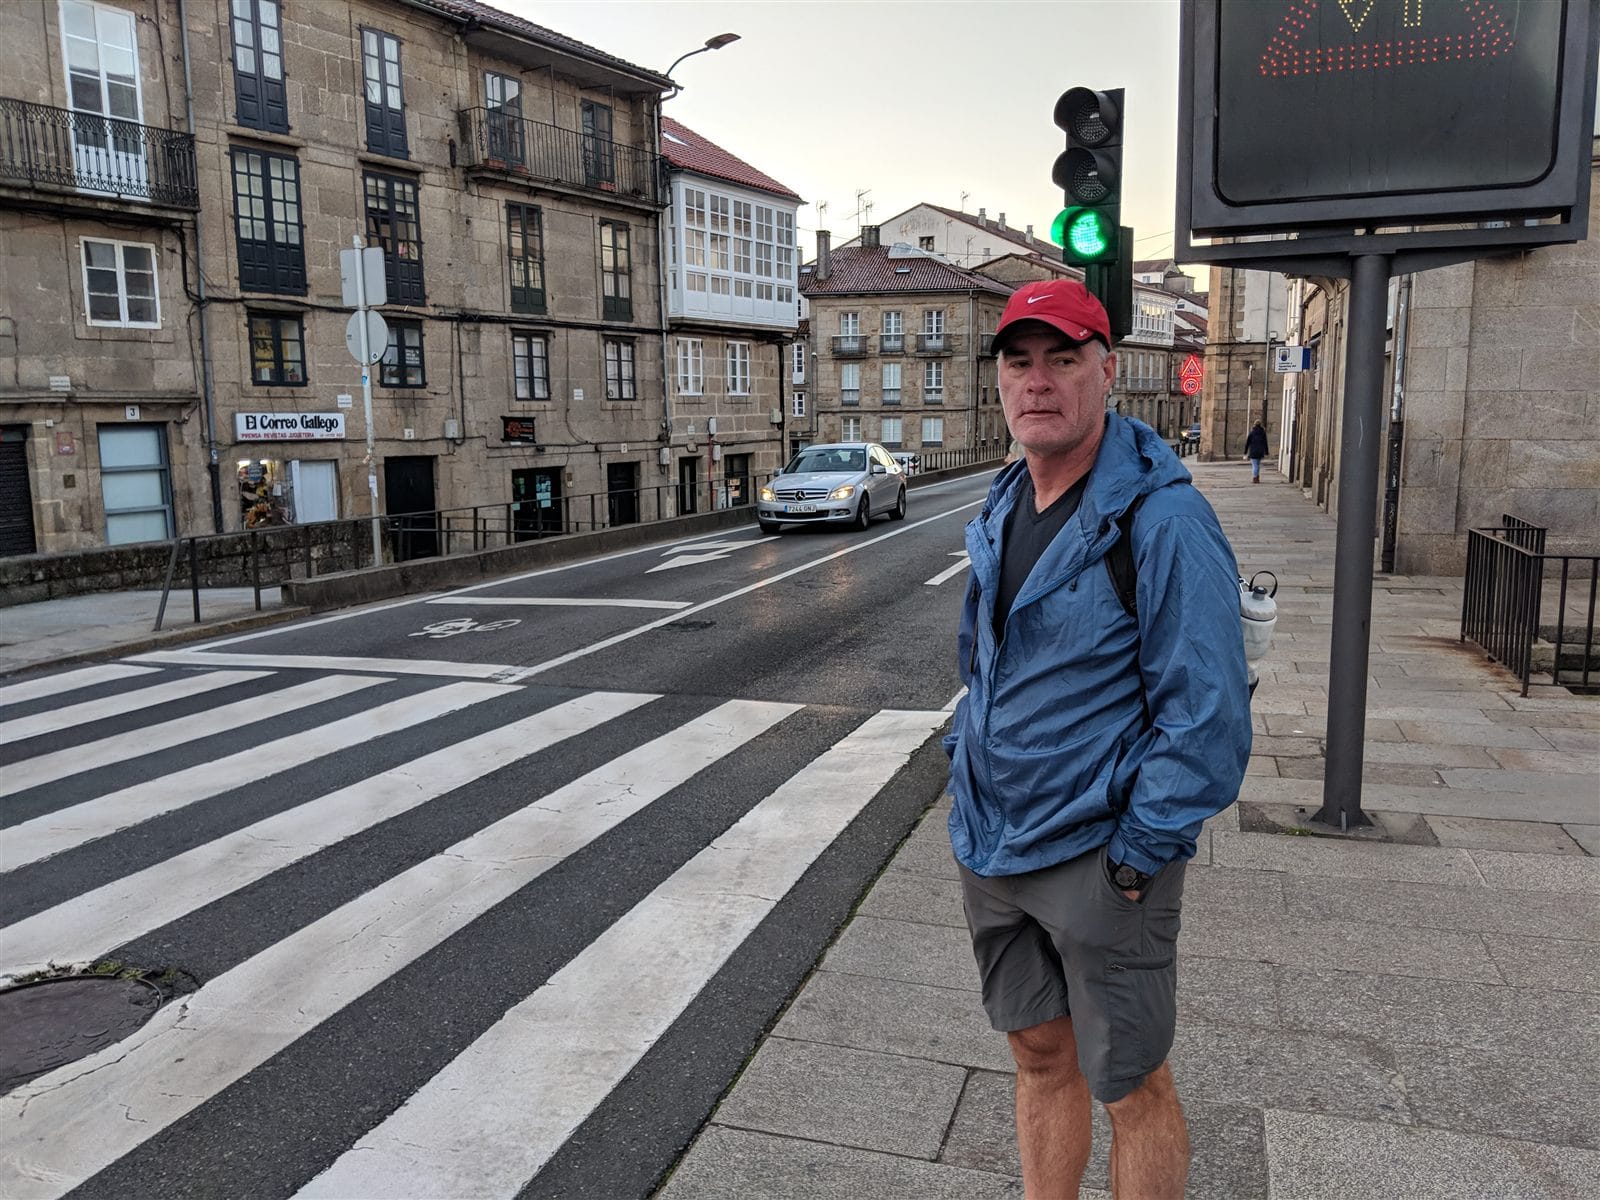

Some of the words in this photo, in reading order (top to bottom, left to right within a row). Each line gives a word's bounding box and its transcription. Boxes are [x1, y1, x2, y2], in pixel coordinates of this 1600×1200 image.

[129, 407, 136, 417] 3
[245, 415, 257, 430] El
[260, 414, 298, 430] Correo
[300, 414, 339, 432] Gallego
